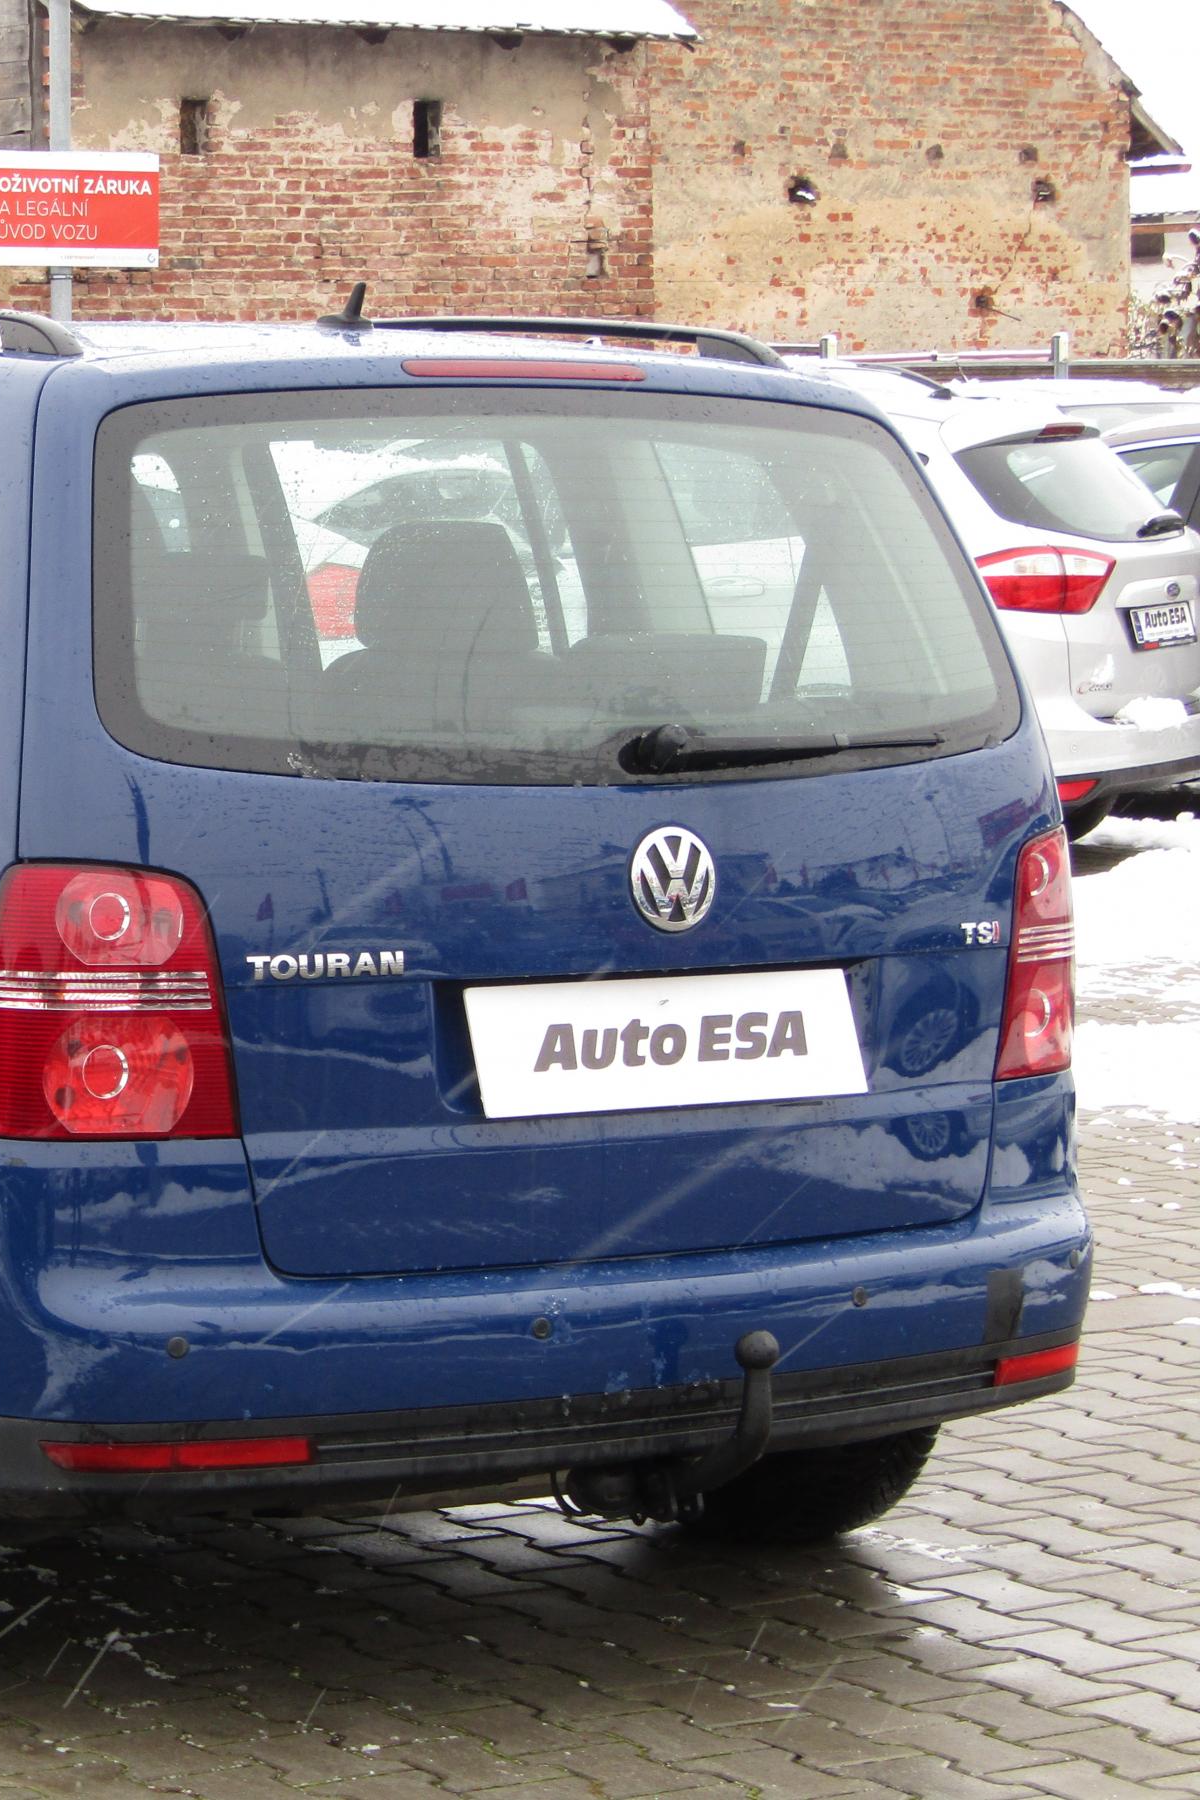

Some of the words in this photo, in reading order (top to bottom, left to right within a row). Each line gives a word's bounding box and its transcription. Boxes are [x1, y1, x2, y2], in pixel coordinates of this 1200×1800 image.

[84, 176, 153, 196] ZÁRUKA
[16, 198, 89, 217] LEGÁLNÍ
[52, 224, 98, 241] VOZU
[1144, 610, 1169, 628] Auto
[1169, 606, 1187, 625] ESA
[961, 920, 1000, 945] TSI
[246, 950, 405, 981] TOURAN
[533, 1018, 687, 1073] Auto
[697, 1010, 808, 1063] ESA
